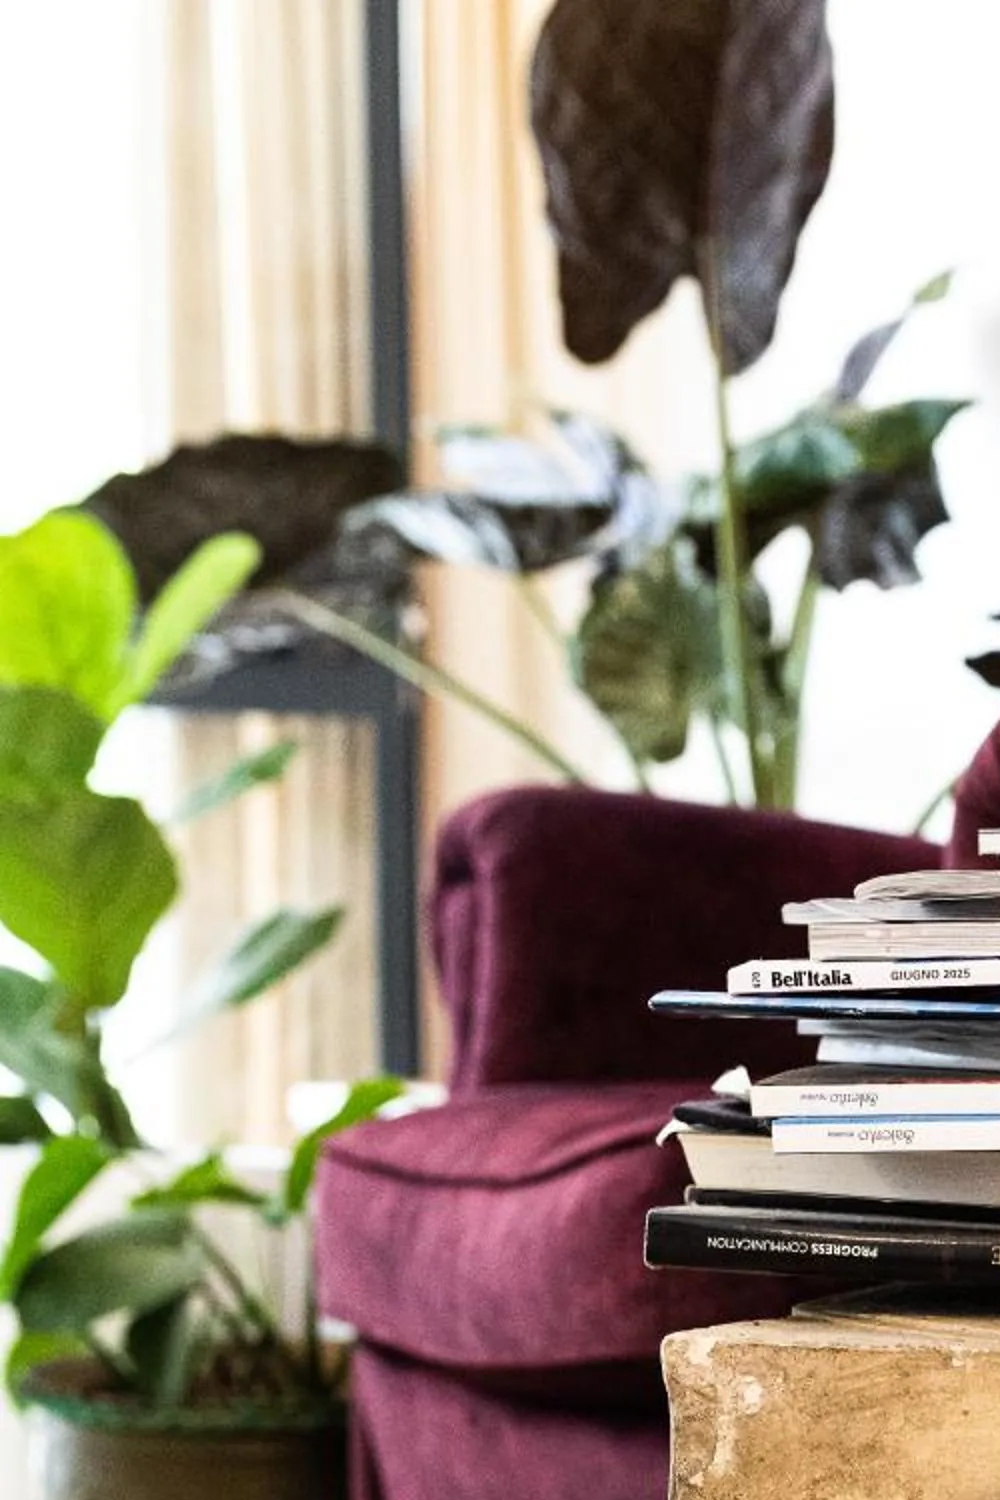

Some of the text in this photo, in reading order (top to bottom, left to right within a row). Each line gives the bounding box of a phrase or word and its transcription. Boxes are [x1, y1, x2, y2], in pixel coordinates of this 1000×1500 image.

[771, 968, 971, 988] Bell'Italia GIUGNO 2025
[707, 1235, 879, 1258] PROGRESS COMMUNICATION
